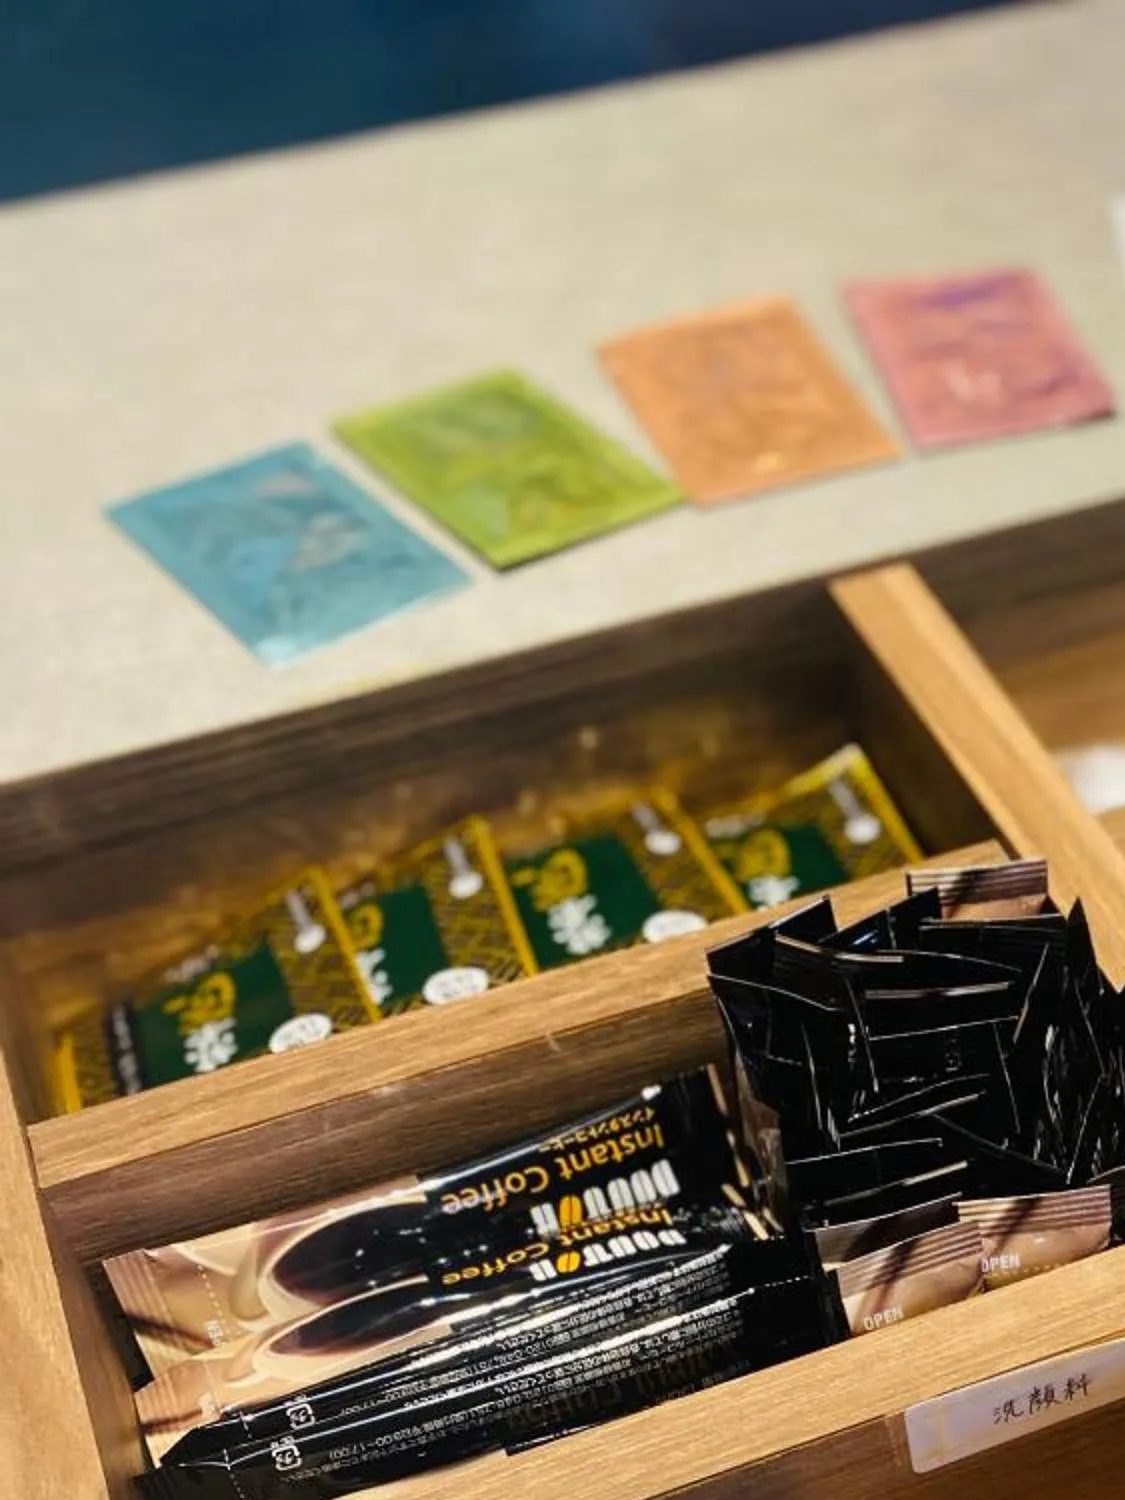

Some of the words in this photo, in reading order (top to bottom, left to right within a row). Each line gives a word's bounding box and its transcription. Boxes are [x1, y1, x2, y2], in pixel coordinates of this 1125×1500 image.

[555, 1124, 664, 1180] Instant
[441, 1165, 549, 1214] Coffee
[558, 1208, 674, 1246] Instant
[441, 1243, 550, 1285] Coffee
[981, 1254, 1021, 1273] OPEN
[993, 1373, 1092, 1425] 洗顔料
